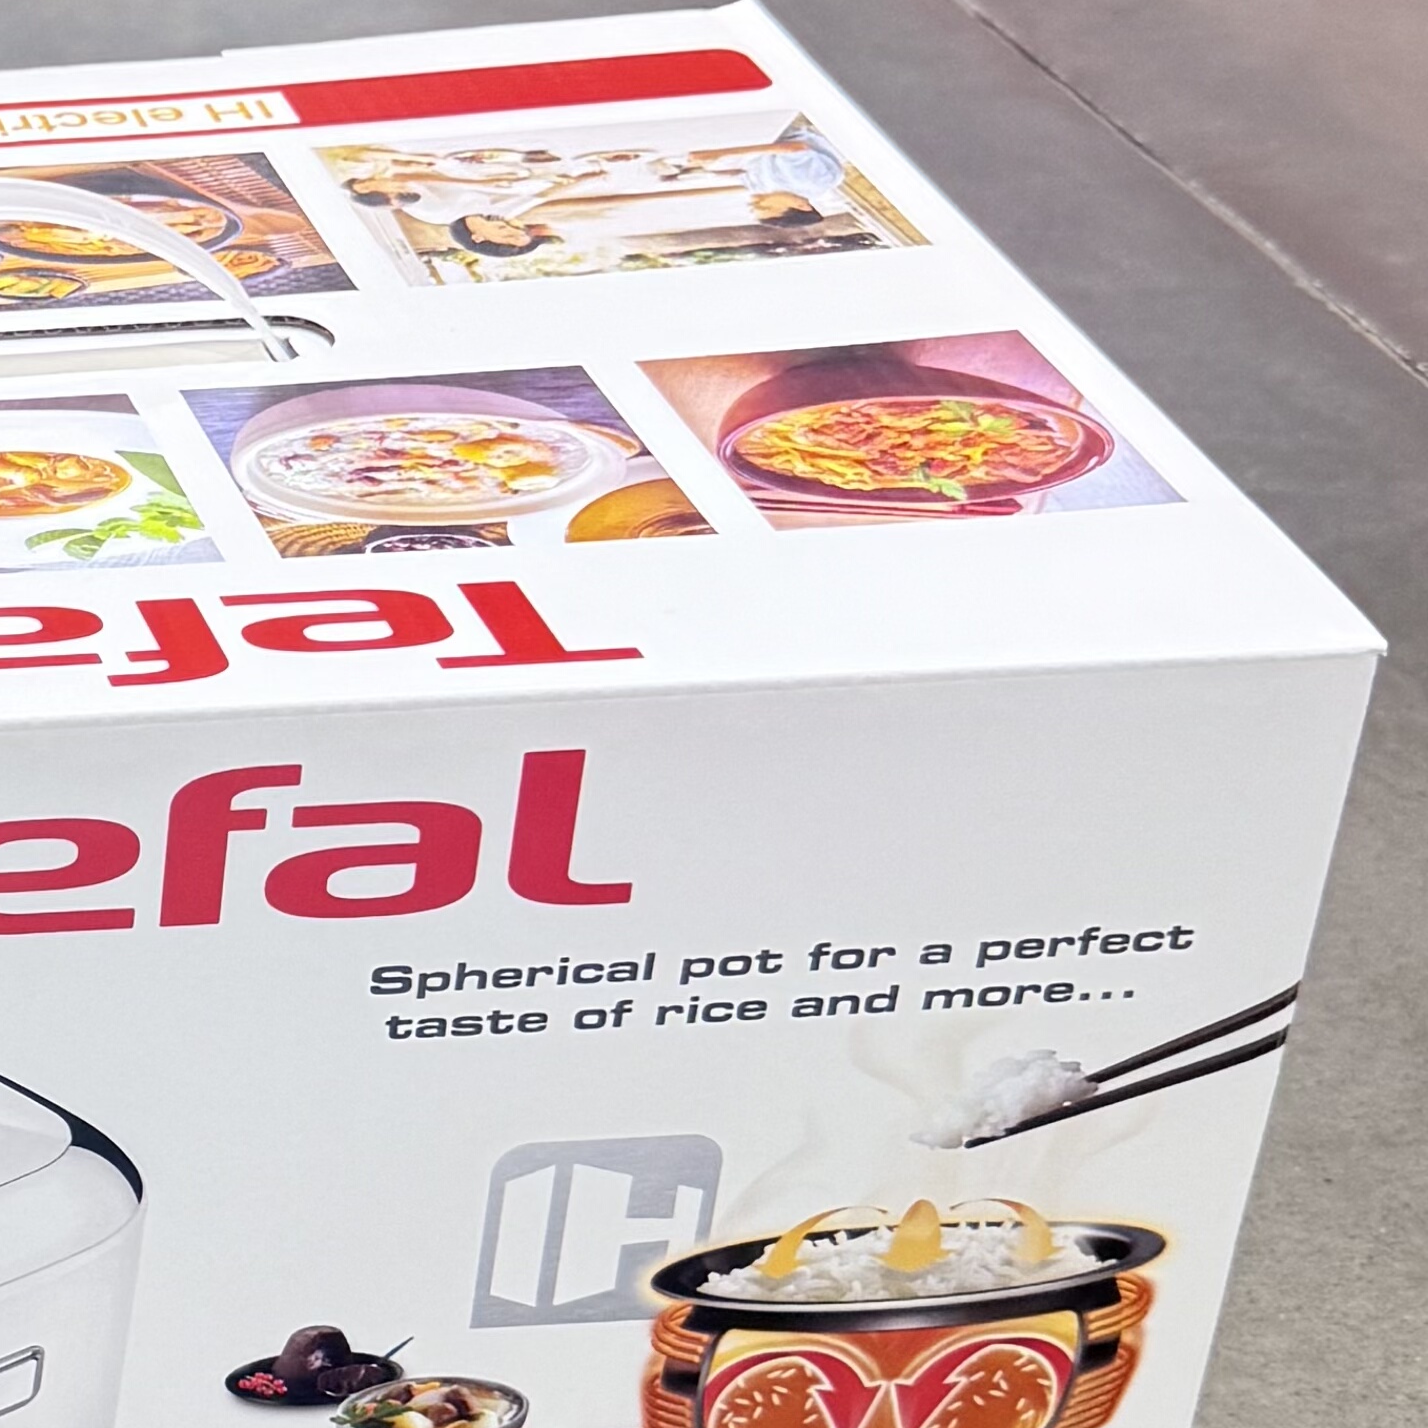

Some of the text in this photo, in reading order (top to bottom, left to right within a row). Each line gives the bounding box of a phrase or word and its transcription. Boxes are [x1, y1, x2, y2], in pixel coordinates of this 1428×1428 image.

[205, 97, 274, 122] IH
[369, 924, 1196, 999] Spherical pot for a perfect
[385, 974, 1137, 1041] taste of rice and more...
